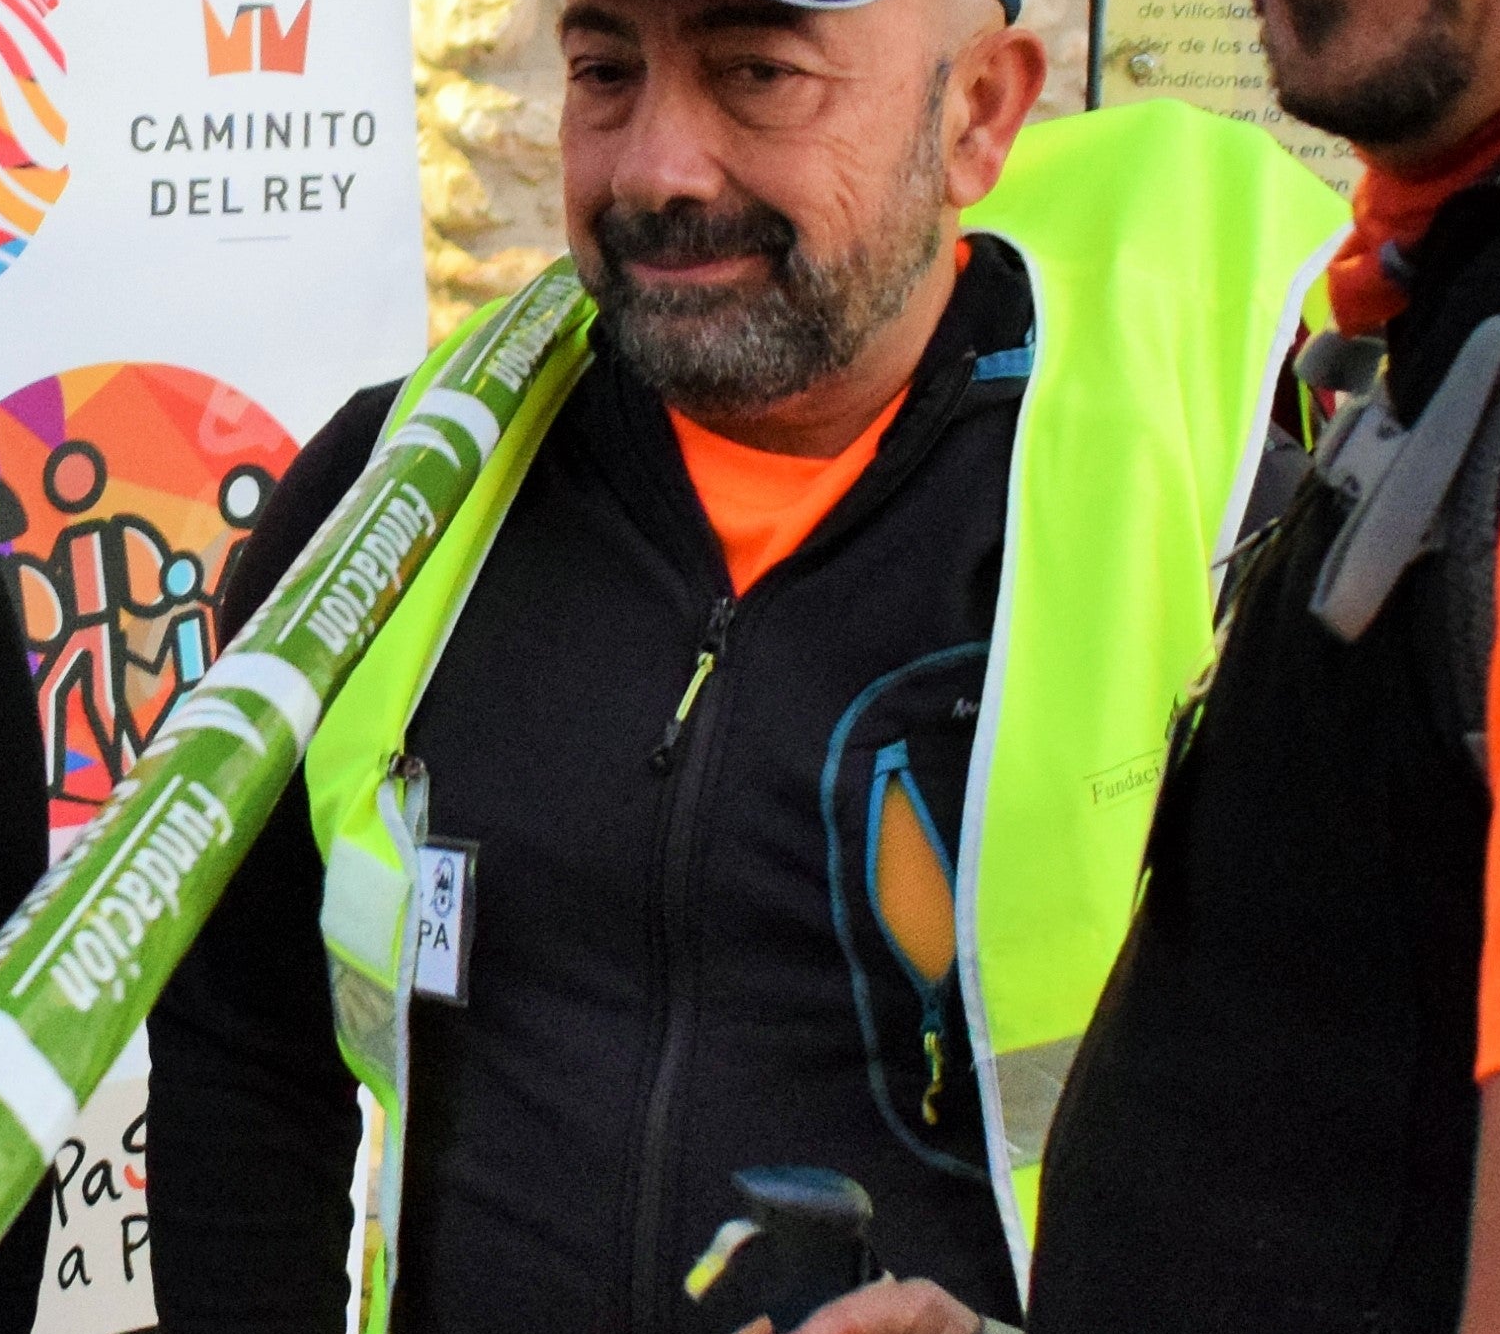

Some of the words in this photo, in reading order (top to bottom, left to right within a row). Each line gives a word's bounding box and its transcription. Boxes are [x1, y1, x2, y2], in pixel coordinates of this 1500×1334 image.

[130, 110, 377, 153] CAMINITO
[150, 178, 244, 218] DEL
[263, 173, 357, 213] REY
[301, 483, 434, 655] Fundación
[53, 772, 232, 1011] Fundación
